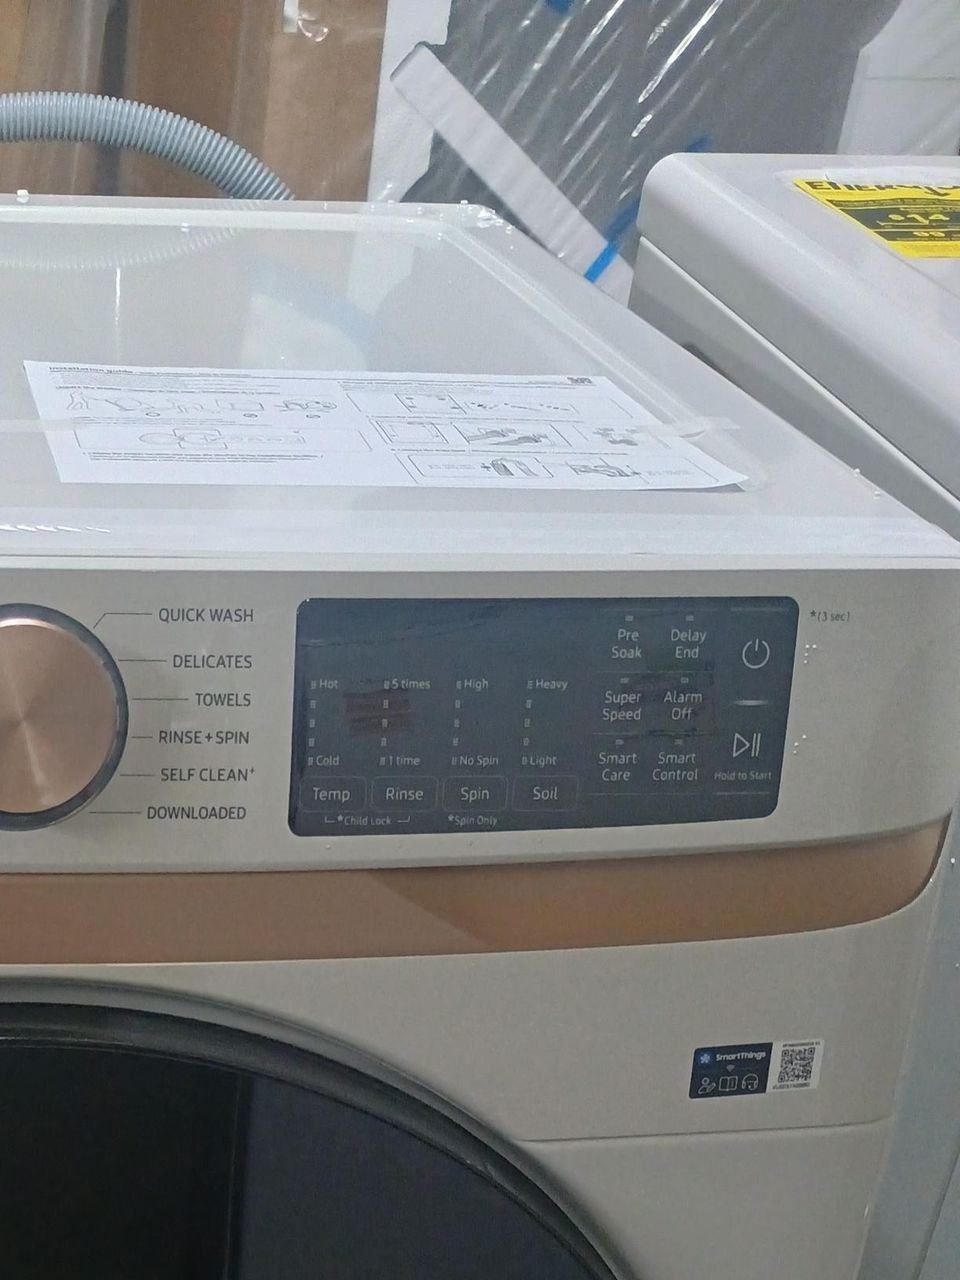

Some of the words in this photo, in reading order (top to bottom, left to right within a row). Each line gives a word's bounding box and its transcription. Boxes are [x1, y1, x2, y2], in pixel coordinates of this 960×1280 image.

[158, 608, 205, 624] QUICK
[208, 608, 254, 623] WASH
[618, 629, 640, 641] Pre
[671, 629, 706, 644] Delay
[611, 646, 642, 659] Soak
[675, 646, 699, 659] End
[172, 654, 252, 669] DELICATES
[319, 679, 338, 689] Hot
[401, 679, 431, 689] times
[464, 679, 488, 690] High
[535, 679, 568, 691] Heavy
[195, 692, 252, 708] TOWELS
[605, 691, 642, 705] Super
[664, 691, 703, 703] Alarm
[602, 708, 642, 722] Speed
[671, 708, 692, 721] Off
[316, 756, 340, 766] Cold
[396, 756, 421, 766] time
[459, 756, 474, 766] No
[476, 755, 499, 768] Spin
[530, 755, 557, 768] Light
[598, 753, 637, 765] Smart
[658, 752, 696, 765] Smart
[160, 768, 196, 783] SELF
[602, 769, 631, 781] Care
[652, 769, 698, 782] Control
[714, 771, 736, 781] Hold
[738, 771, 747, 781] to
[749, 771, 772, 781] Start
[313, 787, 351, 803] Temp
[386, 787, 424, 801] Rinse
[460, 786, 489, 803] Spin
[533, 786, 558, 801] Soil
[146, 805, 247, 820] DOWNLOADED
[370, 815, 391, 826] Lock
[477, 815, 498, 828] Only
[715, 1051, 767, 1062] SmartThings
